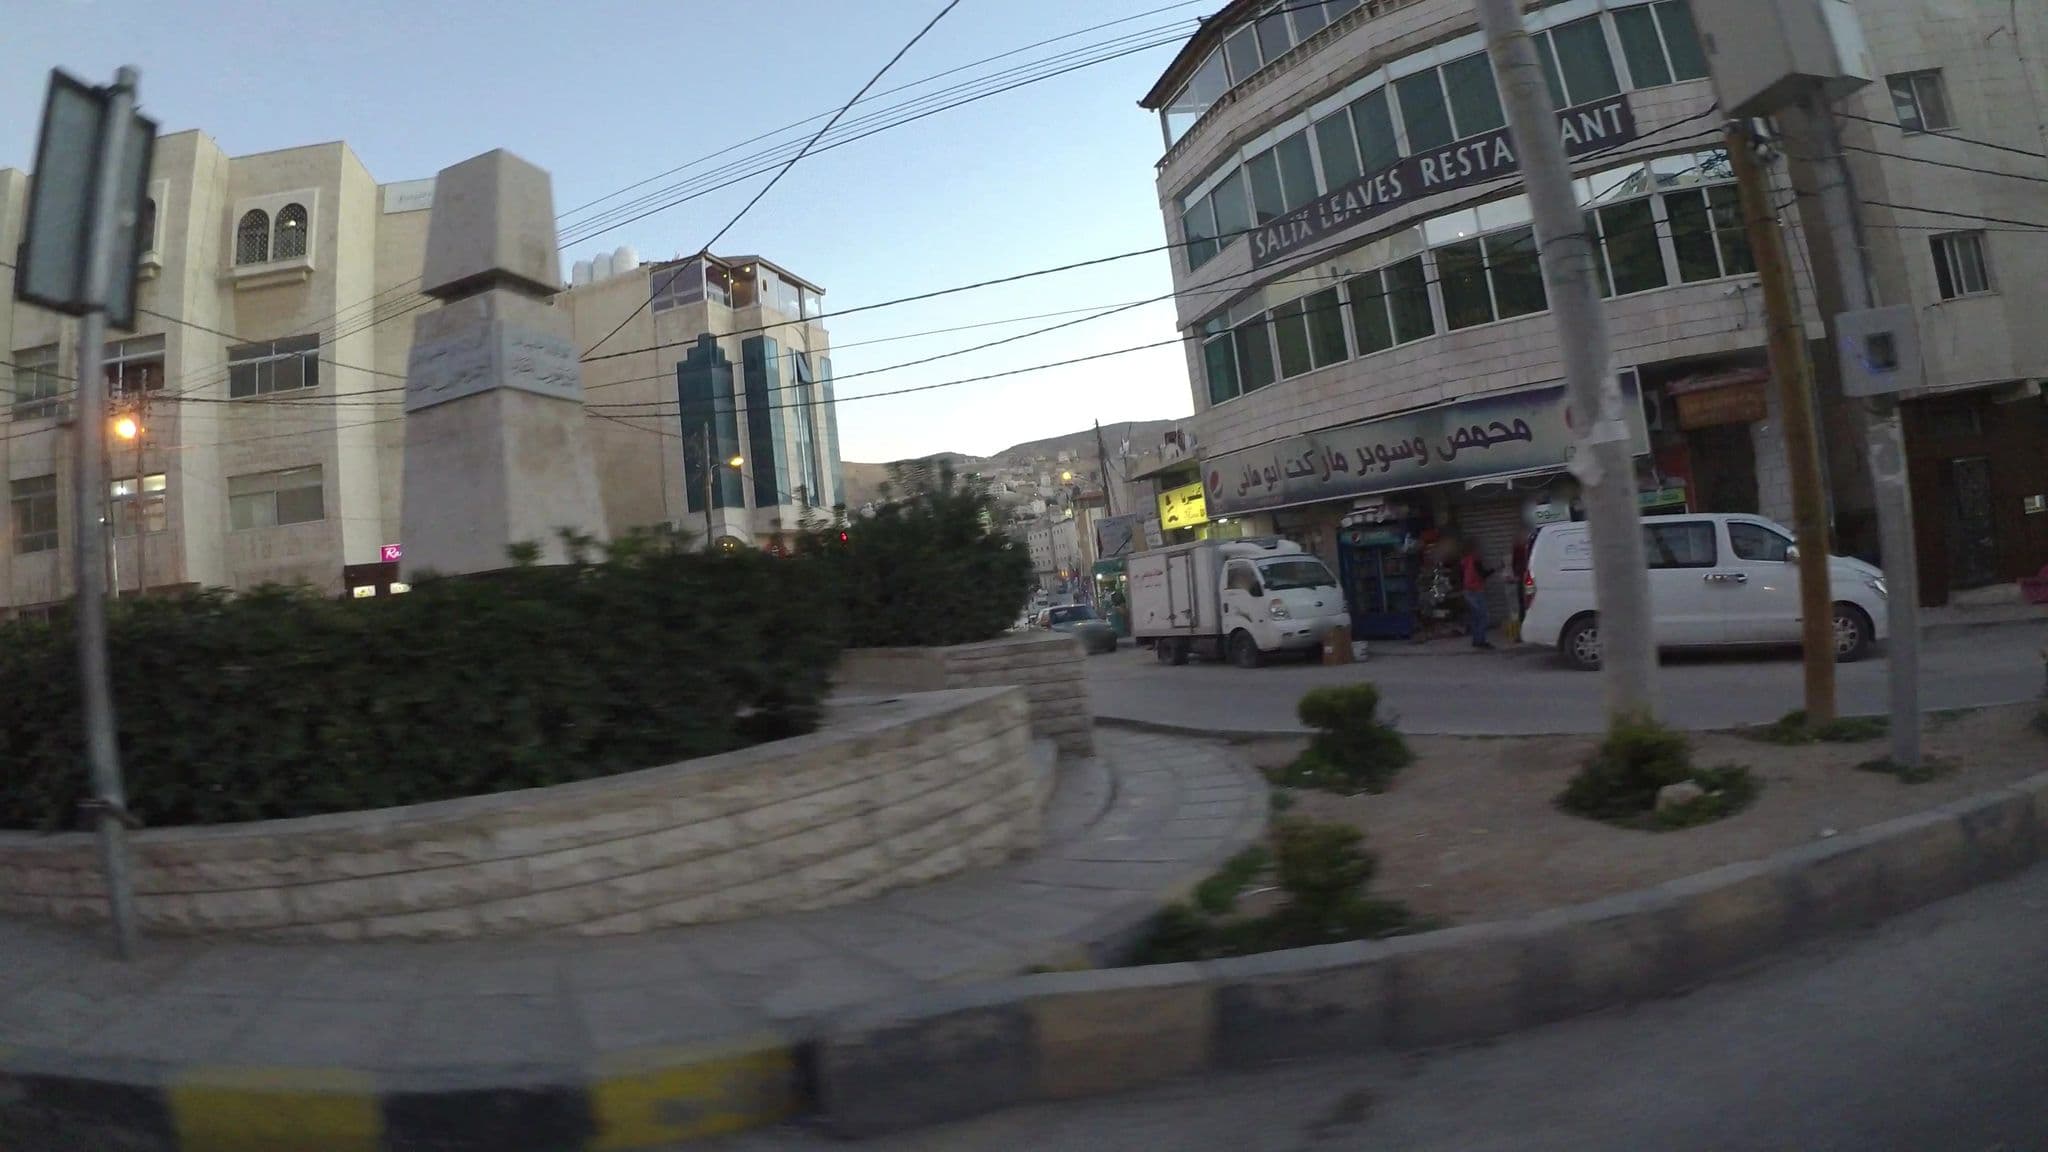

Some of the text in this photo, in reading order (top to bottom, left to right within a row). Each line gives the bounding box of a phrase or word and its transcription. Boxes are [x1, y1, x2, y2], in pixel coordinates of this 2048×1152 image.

[1255, 103, 1623, 258] SALIX LEAVES RESTAANT
[1436, 417, 1533, 462] محمص
